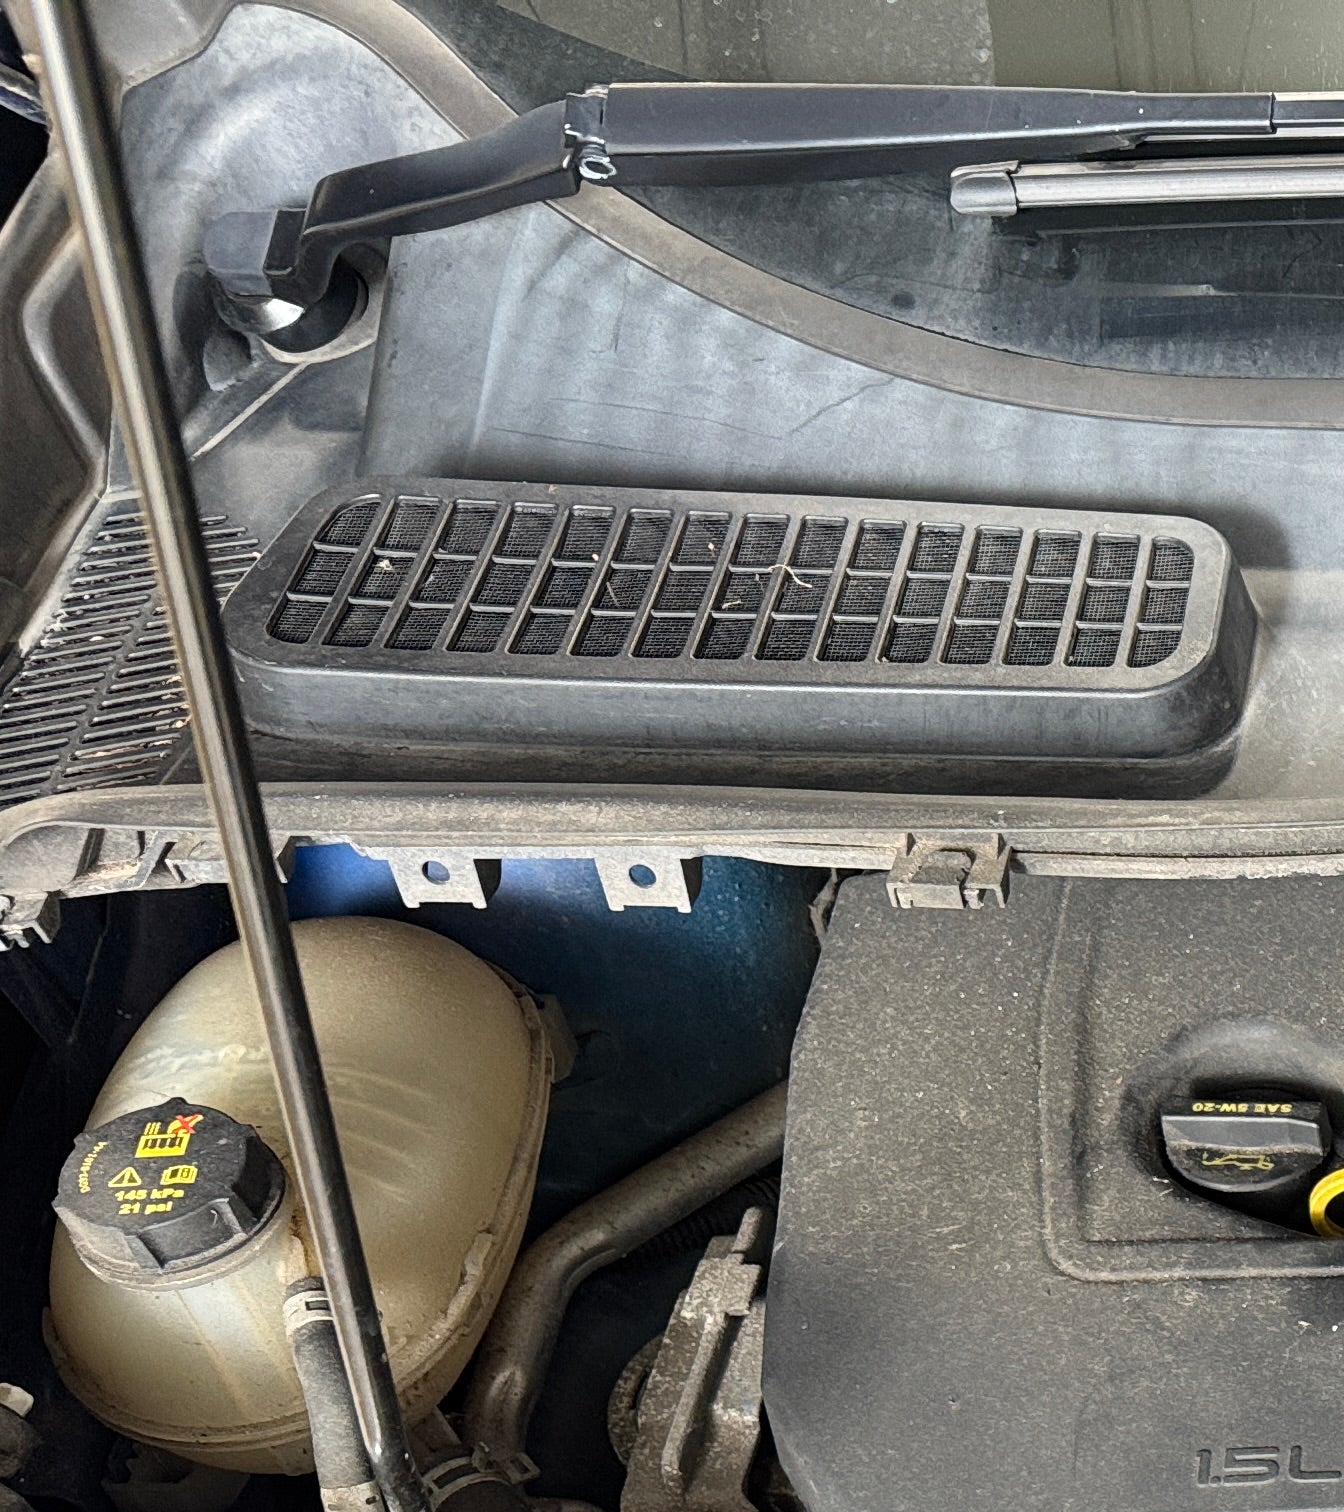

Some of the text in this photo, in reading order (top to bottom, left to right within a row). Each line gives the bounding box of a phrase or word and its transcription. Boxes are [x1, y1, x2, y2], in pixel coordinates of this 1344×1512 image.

[1192, 1102, 1293, 1113] SAE 5W-20
[114, 1188, 185, 1201] 145 kPa
[118, 1201, 174, 1215] 21 psi
[1196, 1444, 1342, 1488] 1.5L
